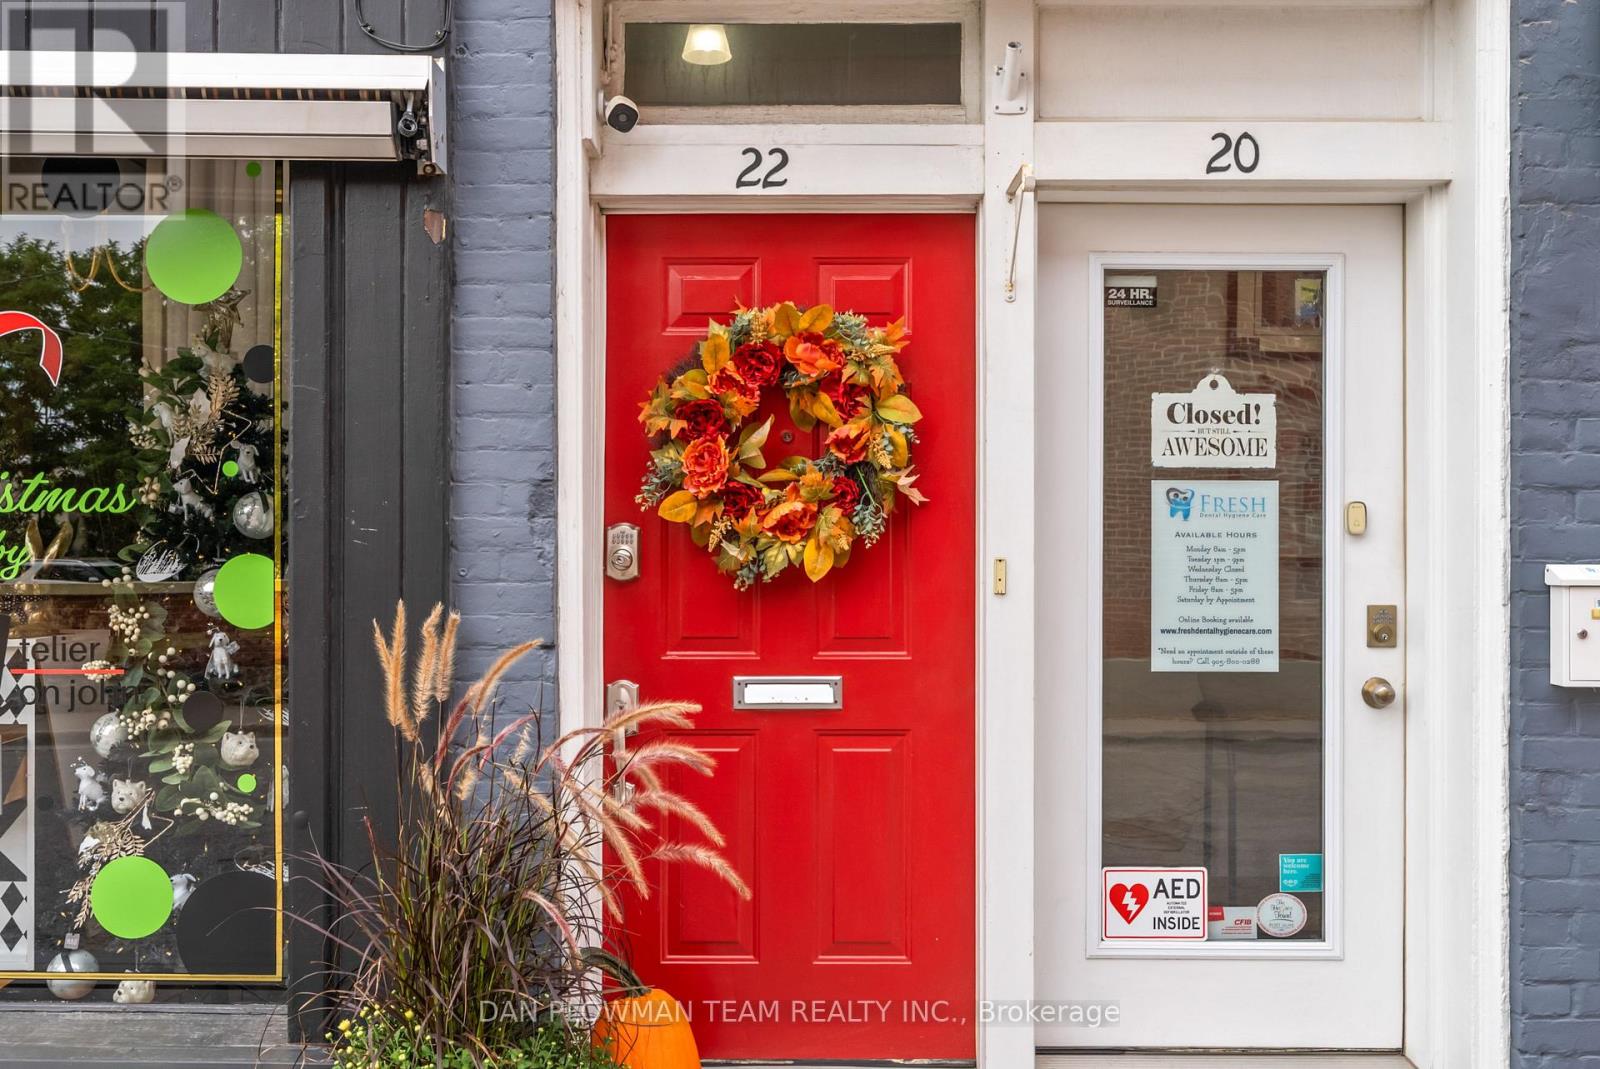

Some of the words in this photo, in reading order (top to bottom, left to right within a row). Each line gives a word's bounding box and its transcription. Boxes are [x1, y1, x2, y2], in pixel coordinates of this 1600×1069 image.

[1206, 132, 1260, 174] 20
[736, 147, 789, 189] 22
[1108, 288, 1126, 299] 24
[1130, 288, 1154, 299] HR.
[1167, 402, 1261, 425] Closed!
[1212, 427, 1231, 435] STILL
[1162, 437, 1268, 457] AWESOME
[1200, 495, 1266, 513] FRESH
[1186, 545, 1212, 554] Monday
[1187, 555, 1211, 564] Tuesday
[1188, 565, 1222, 574] Wednesday
[1184, 575, 1213, 584] Thursday
[1188, 585, 1209, 595] Friday
[1177, 595, 1205, 605] Saturday
[1206, 595, 1214, 605] by
[1216, 596, 1255, 605] Appointment
[1178, 615, 1200, 623] Online
[1201, 616, 1227, 625] Booking
[1160, 627, 1272, 636] www.freshdentalhygienecare.com
[1187, 648, 1224, 656] appointment
[1196, 657, 1210, 665] Call
[1153, 878, 1200, 899] AED
[1153, 917, 1200, 930] INSIDE
